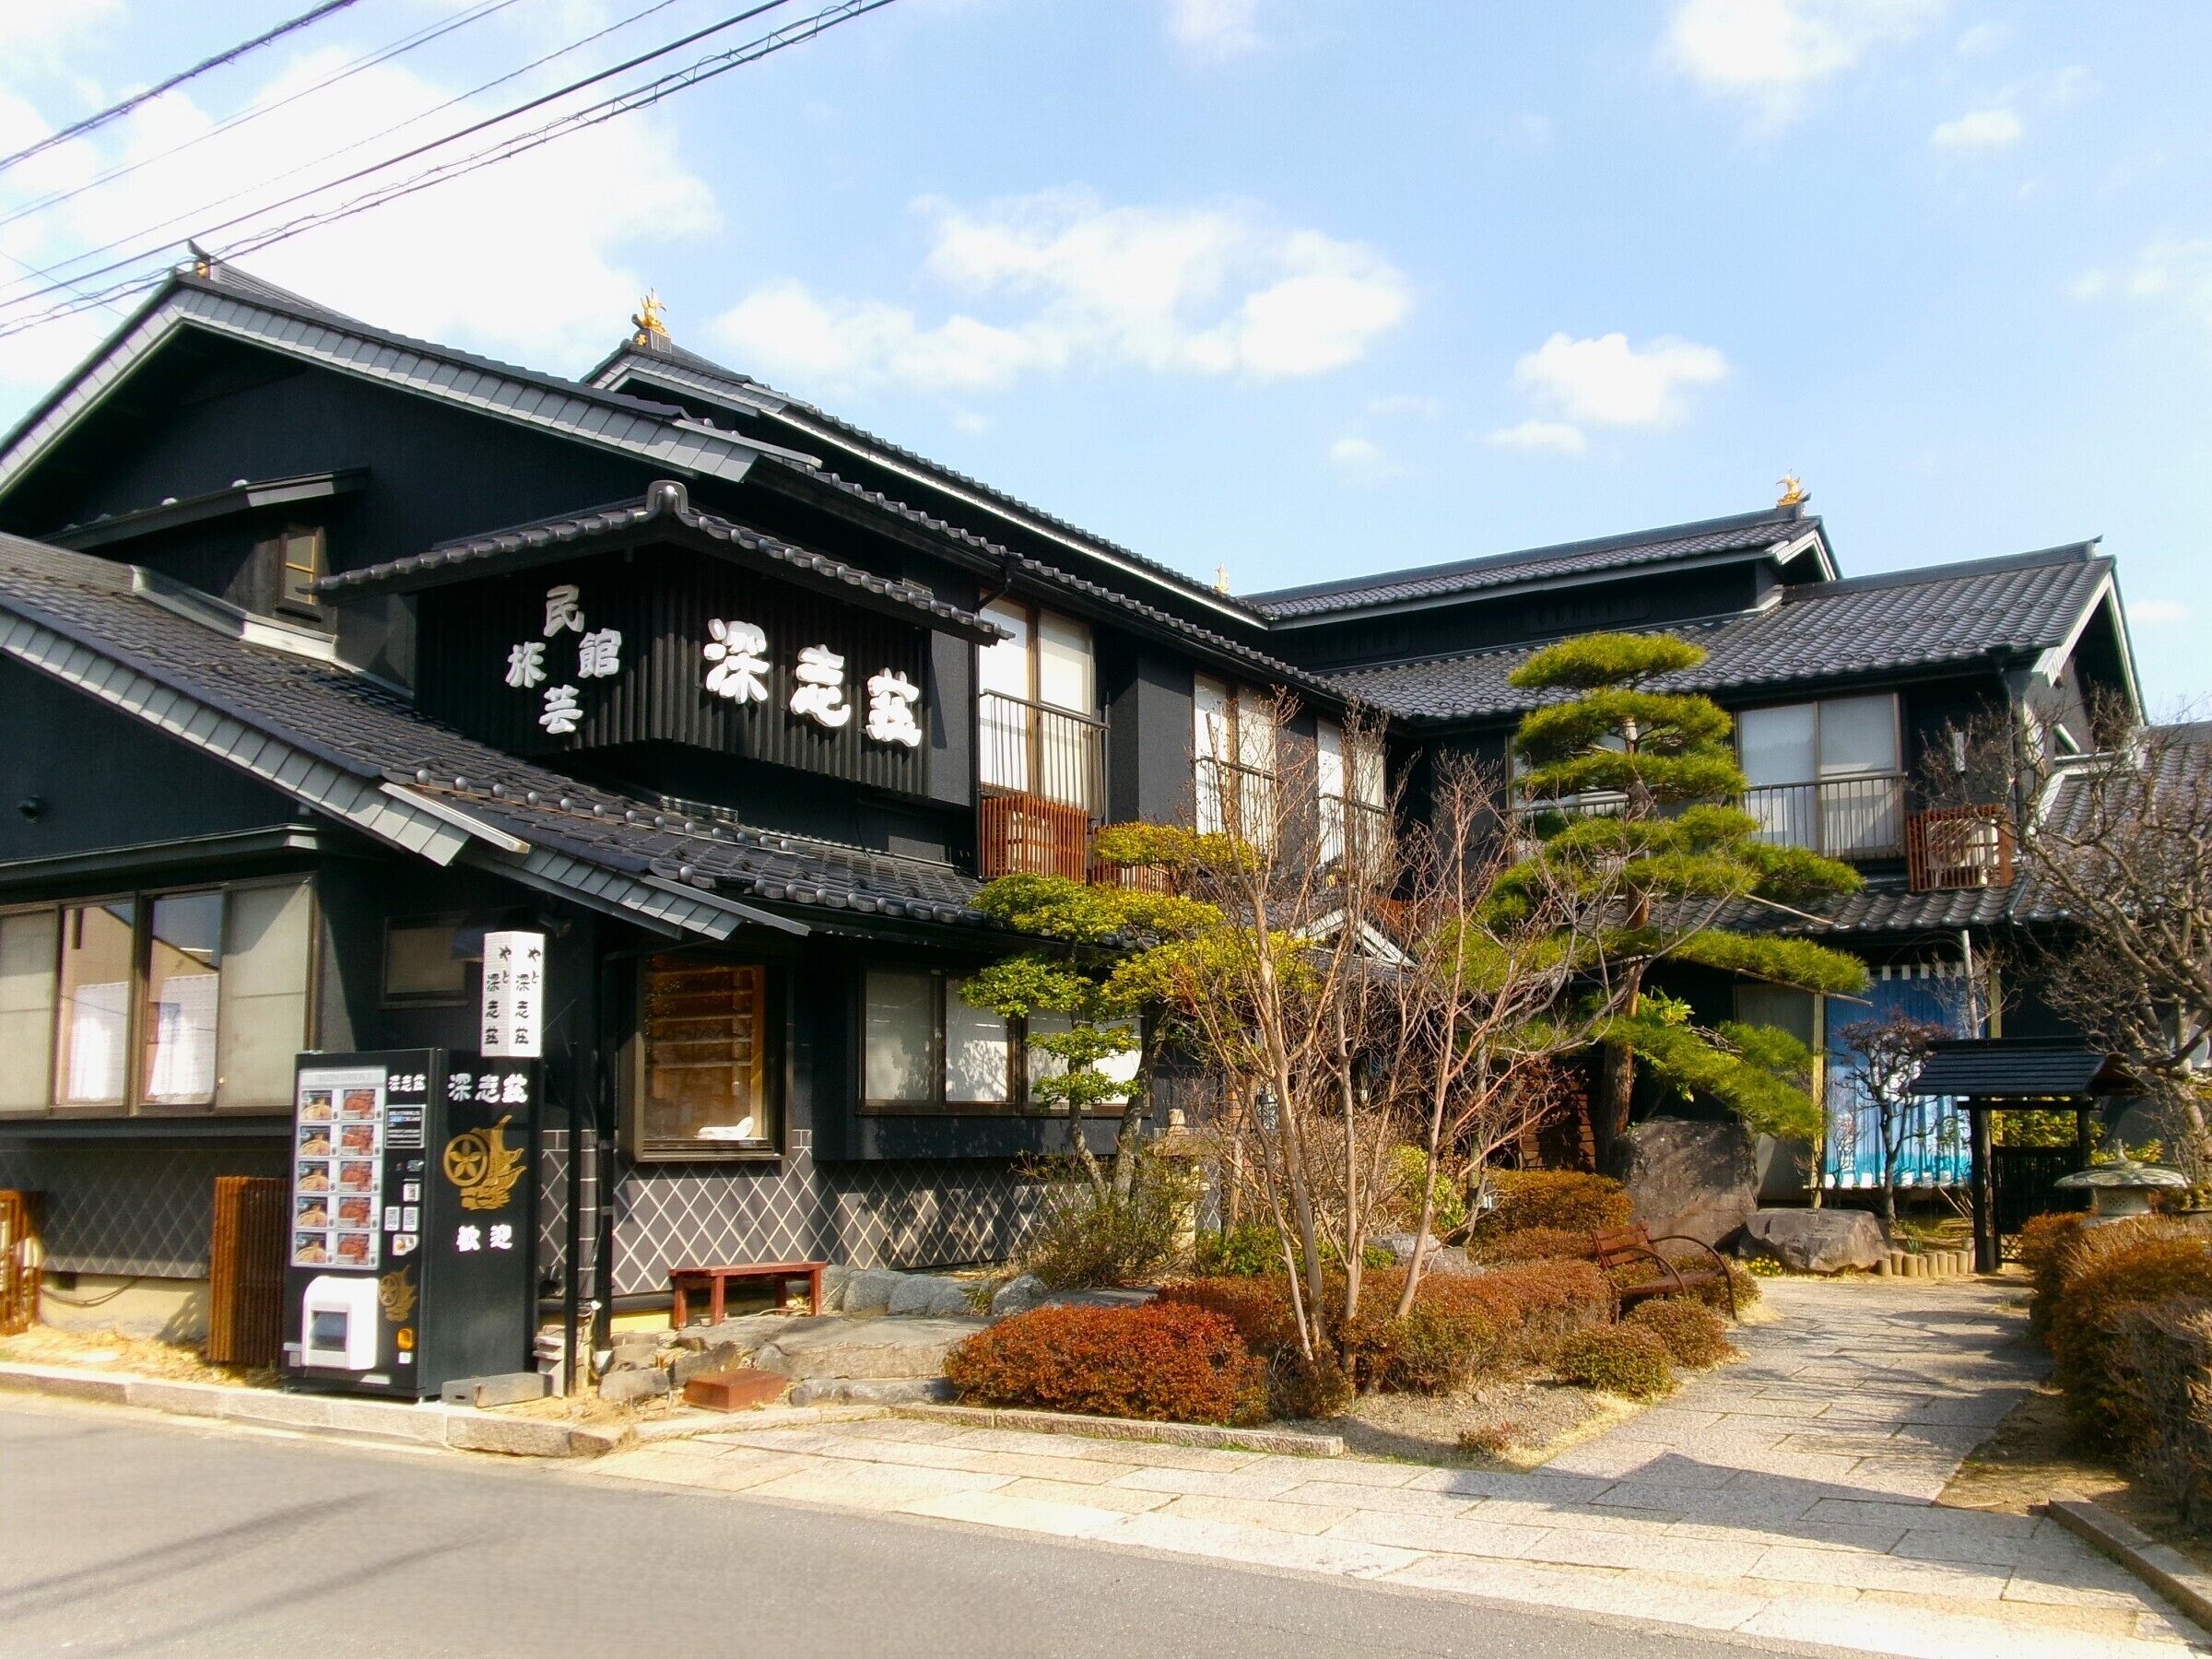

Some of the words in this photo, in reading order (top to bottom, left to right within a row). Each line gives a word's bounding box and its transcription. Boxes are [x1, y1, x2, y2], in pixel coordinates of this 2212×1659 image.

[704, 618, 923, 747] 深志荘
[485, 973, 500, 1045] 深志荘
[514, 973, 530, 1045] 深志荘
[447, 1072, 529, 1104] 深志荘
